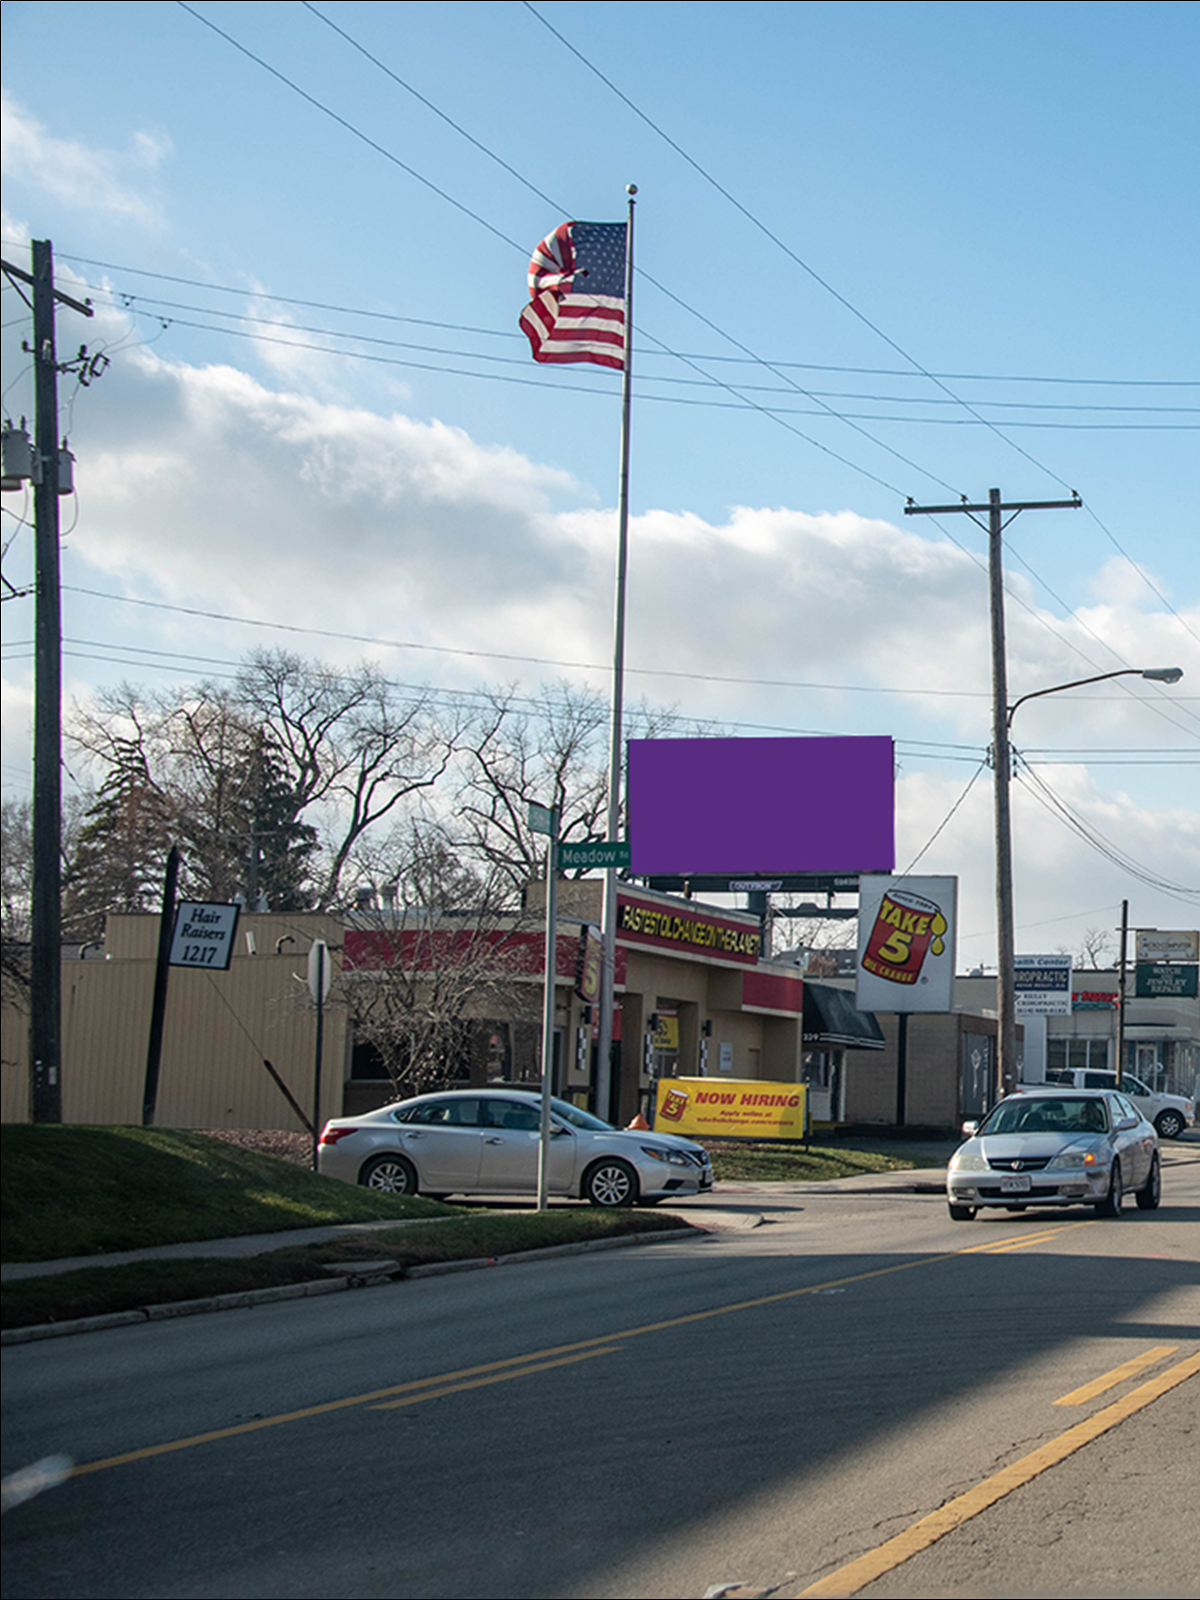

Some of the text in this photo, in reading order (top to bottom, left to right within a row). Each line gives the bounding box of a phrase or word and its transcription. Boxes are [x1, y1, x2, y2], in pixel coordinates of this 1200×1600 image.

[562, 849, 617, 864] Meadow
[190, 908, 222, 924] Hair
[879, 900, 931, 936] TAKE
[181, 923, 226, 940] Raisers
[182, 945, 217, 964] 1217
[878, 929, 911, 963] 5
[695, 1092, 800, 1107] NOW HIRING
